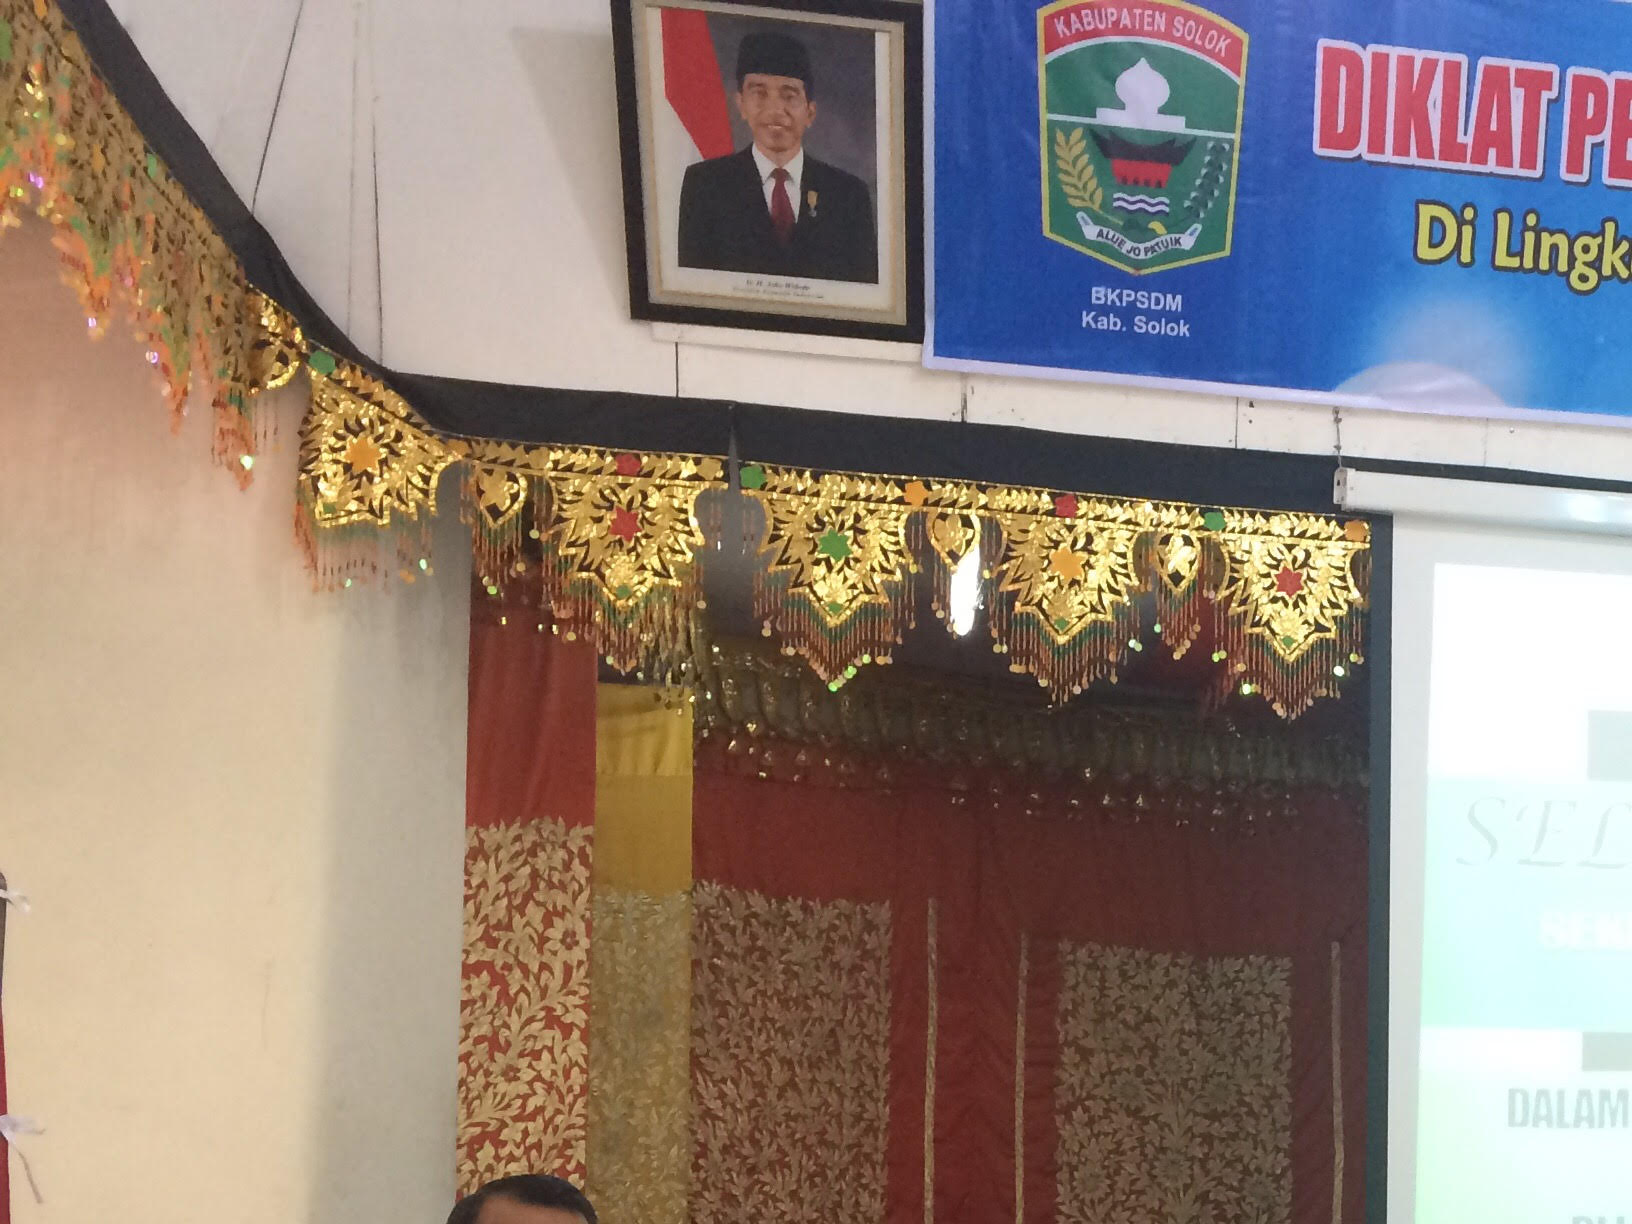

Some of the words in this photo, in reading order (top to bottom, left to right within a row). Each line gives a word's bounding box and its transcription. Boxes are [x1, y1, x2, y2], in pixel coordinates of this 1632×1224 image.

[1055, 8, 1166, 38] KABUPATEN
[1172, 16, 1232, 57] SOLOK
[1315, 42, 1559, 174] DIKLAT
[1096, 229, 1126, 249] ALUE
[1126, 244, 1141, 257] JO
[1143, 236, 1182, 257] PATUIK
[1416, 203, 1474, 266] Di
[1091, 286, 1183, 312] BKPSDM
[1081, 310, 1127, 332] Kab.
[1133, 315, 1190, 337] Solok
[1507, 1087, 1629, 1129] DALAM
